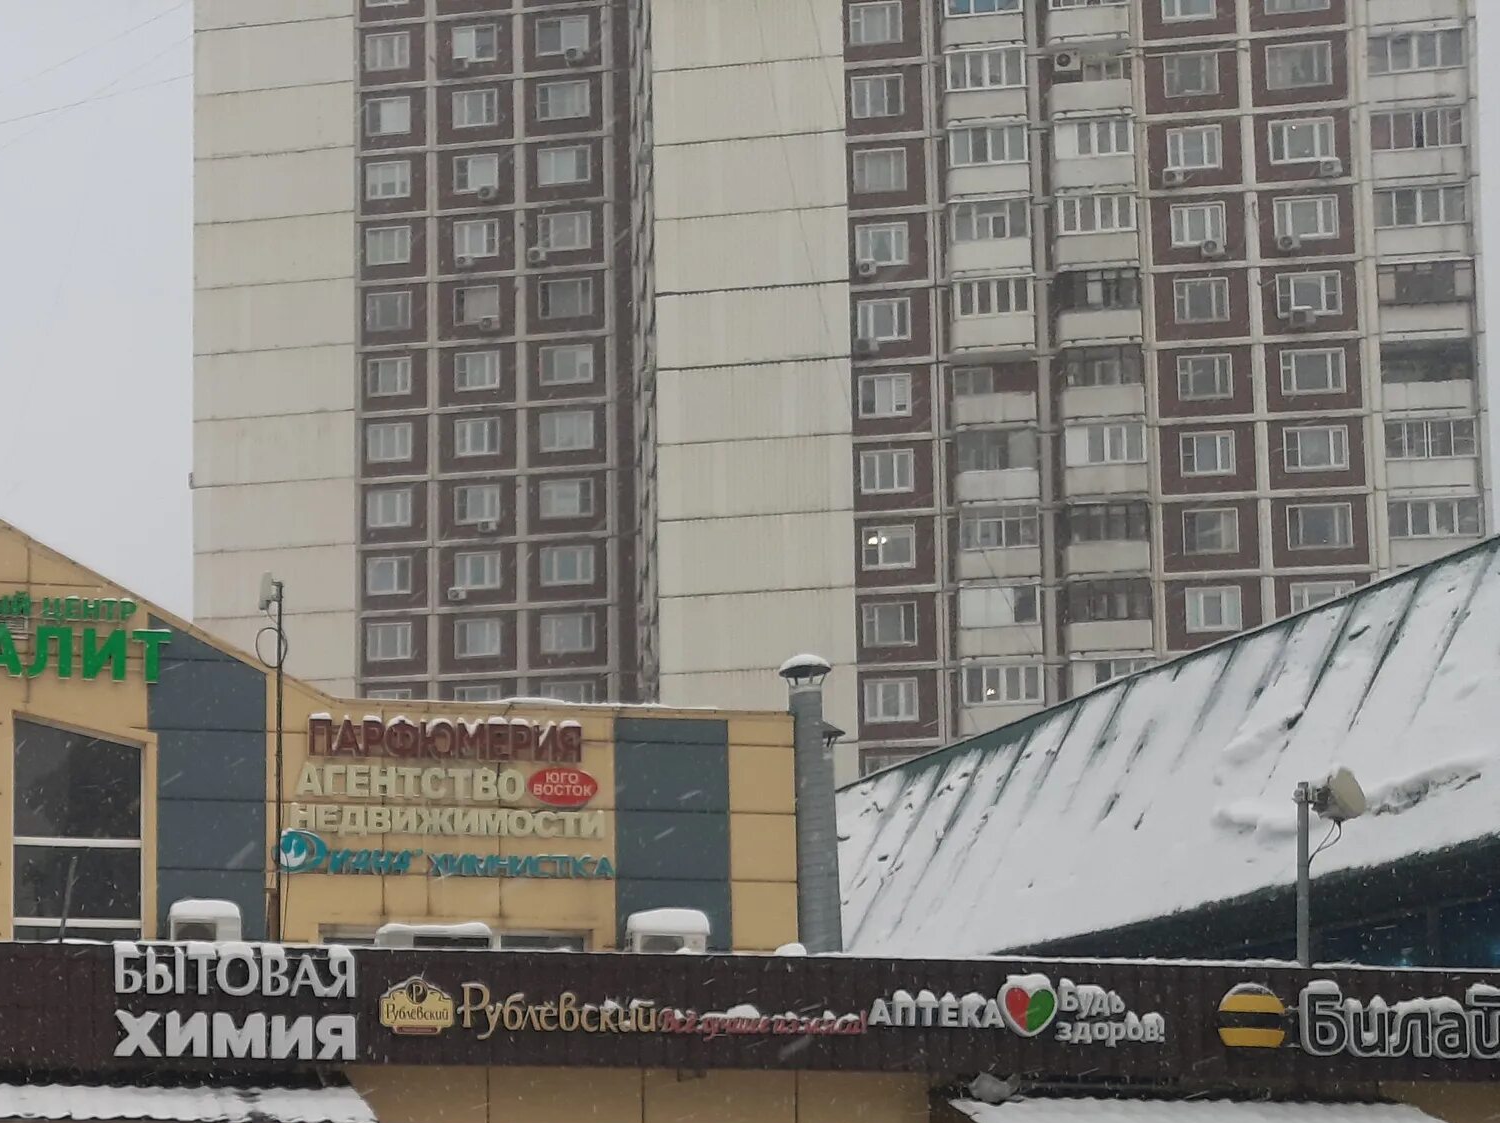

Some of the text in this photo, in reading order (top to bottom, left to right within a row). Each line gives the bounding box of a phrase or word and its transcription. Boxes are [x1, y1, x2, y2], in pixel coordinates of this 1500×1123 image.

[43, 597, 137, 622] ЦЕНТР
[308, 715, 583, 763] ПАРФЮМЕРИЯ
[296, 763, 525, 801] АГЕНТСТВО
[533, 783, 593, 797] ВОСТОК
[545, 772, 579, 784] ЮГО
[290, 804, 605, 839] НЕДВИЖИМОСТИ
[113, 943, 356, 998] БЫТОВАЯ
[457, 983, 657, 1040] Рублёвский
[868, 994, 1006, 1028] АПТЕКА
[1057, 979, 1126, 1019] Будь
[113, 1009, 357, 1061] ХИМИЯ
[1055, 1013, 1166, 1048] здоров!
